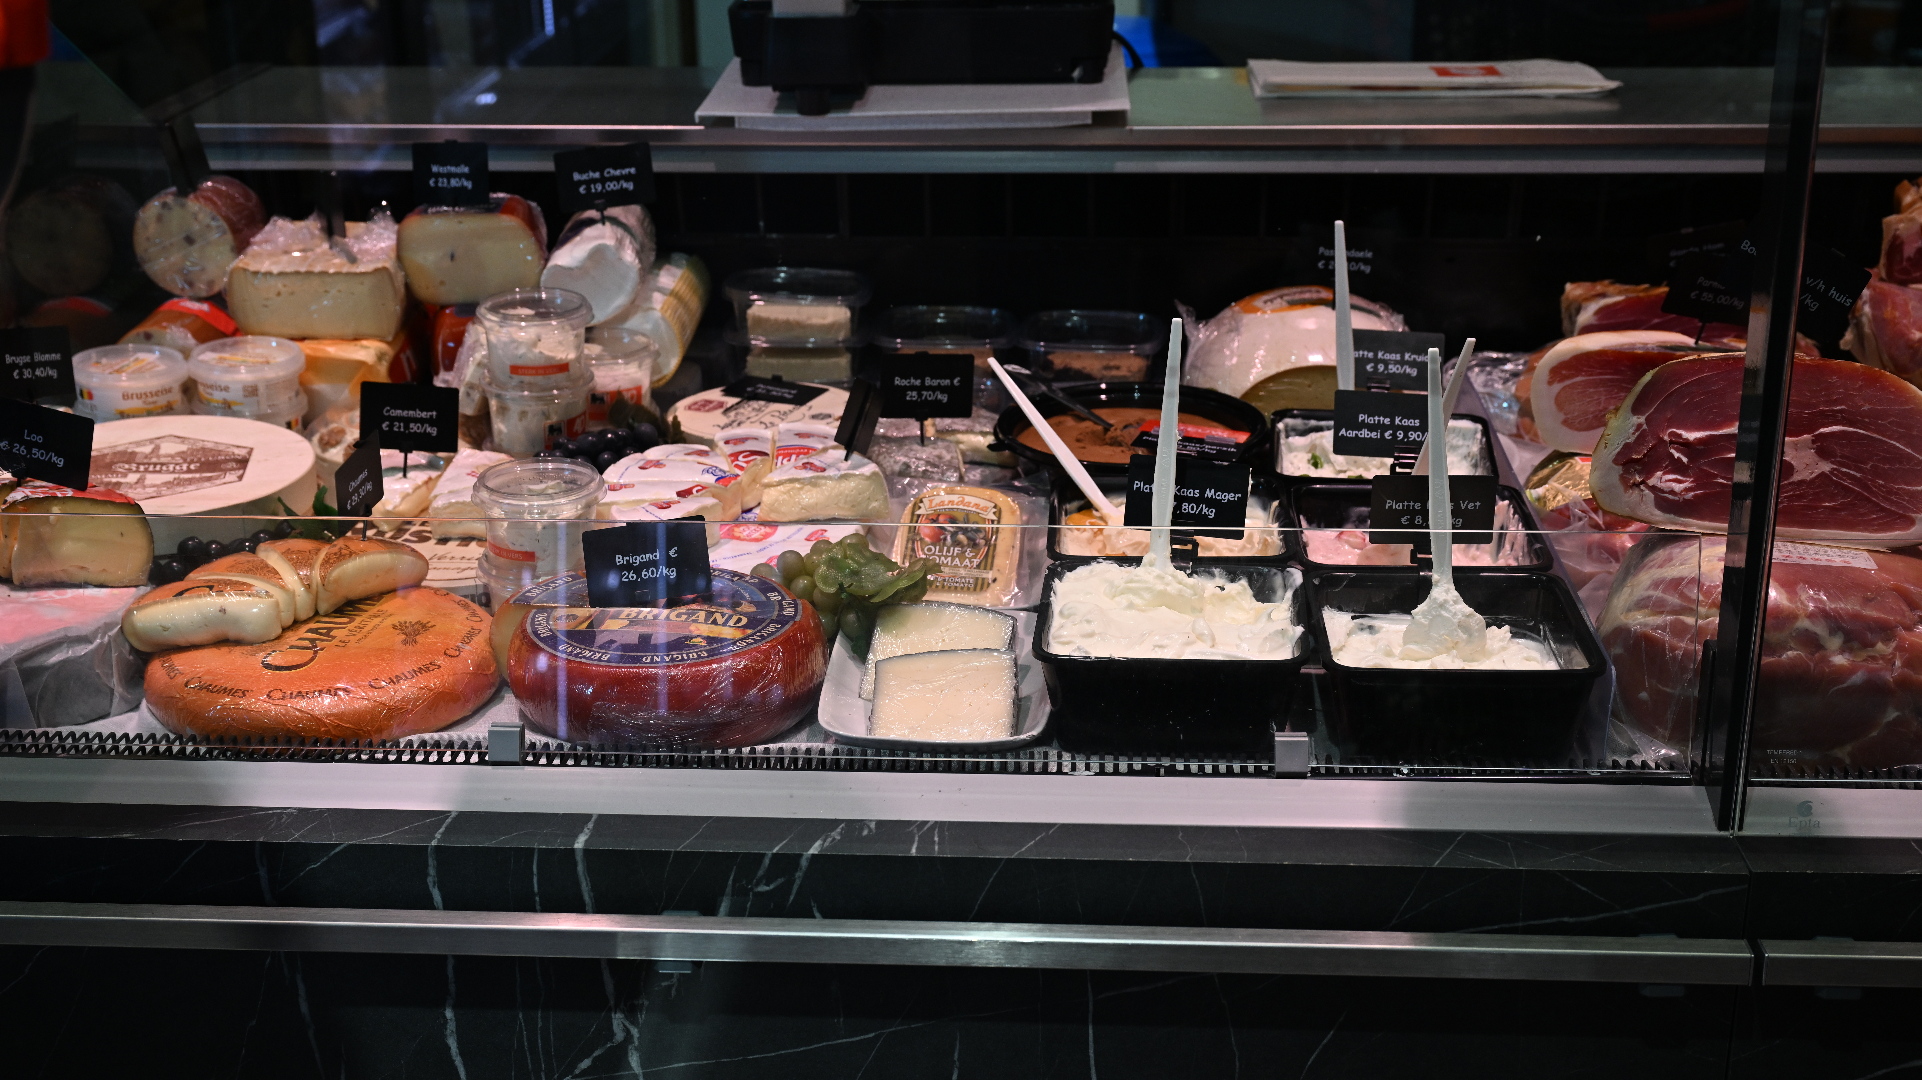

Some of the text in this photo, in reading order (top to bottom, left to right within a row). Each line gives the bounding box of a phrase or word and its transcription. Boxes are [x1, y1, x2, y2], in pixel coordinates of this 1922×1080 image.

[431, 164, 470, 174] Westmalle
[573, 167, 637, 181] Buche Chevre
[429, 177, 436, 187] €
[579, 179, 634, 194] € 19,00/kg
[1318, 260, 1326, 269] €
[1690, 291, 1699, 300] €
[1806, 276, 1826, 293] v/h
[1829, 286, 1853, 307] huis
[5, 354, 31, 367] Brugse
[1353, 350, 1374, 359] atte
[1378, 350, 1401, 360] Kaas
[13, 366, 58, 380] € 30,40/kg
[1366, 363, 1418, 377] € 9,50/kg
[895, 377, 961, 386] Roche Baron €
[906, 391, 948, 403] 25,70/kg
[383, 406, 437, 419] Camembert
[1358, 413, 1420, 427] Platte Kaas
[382, 421, 437, 436] € 21,50/kg
[1338, 428, 1381, 439] Aardbei
[1384, 430, 1393, 440] €
[24, 429, 43, 443] Loo
[12, 443, 65, 467] 26,50/kg
[1204, 487, 1242, 503] Mager
[928, 496, 990, 513] Landana
[1385, 500, 1422, 510] Platte
[1460, 500, 1481, 510] Vet
[1401, 515, 1411, 525] €
[615, 547, 678, 566] Brigand €
[924, 545, 976, 558] OLIJF &
[924, 555, 980, 568] OMAAT
[621, 565, 677, 582] 26,60/kg
[617, 607, 749, 628] BRIGAND
[368, 661, 441, 689] CHAUMES
[184, 677, 251, 699] CHAUMES
